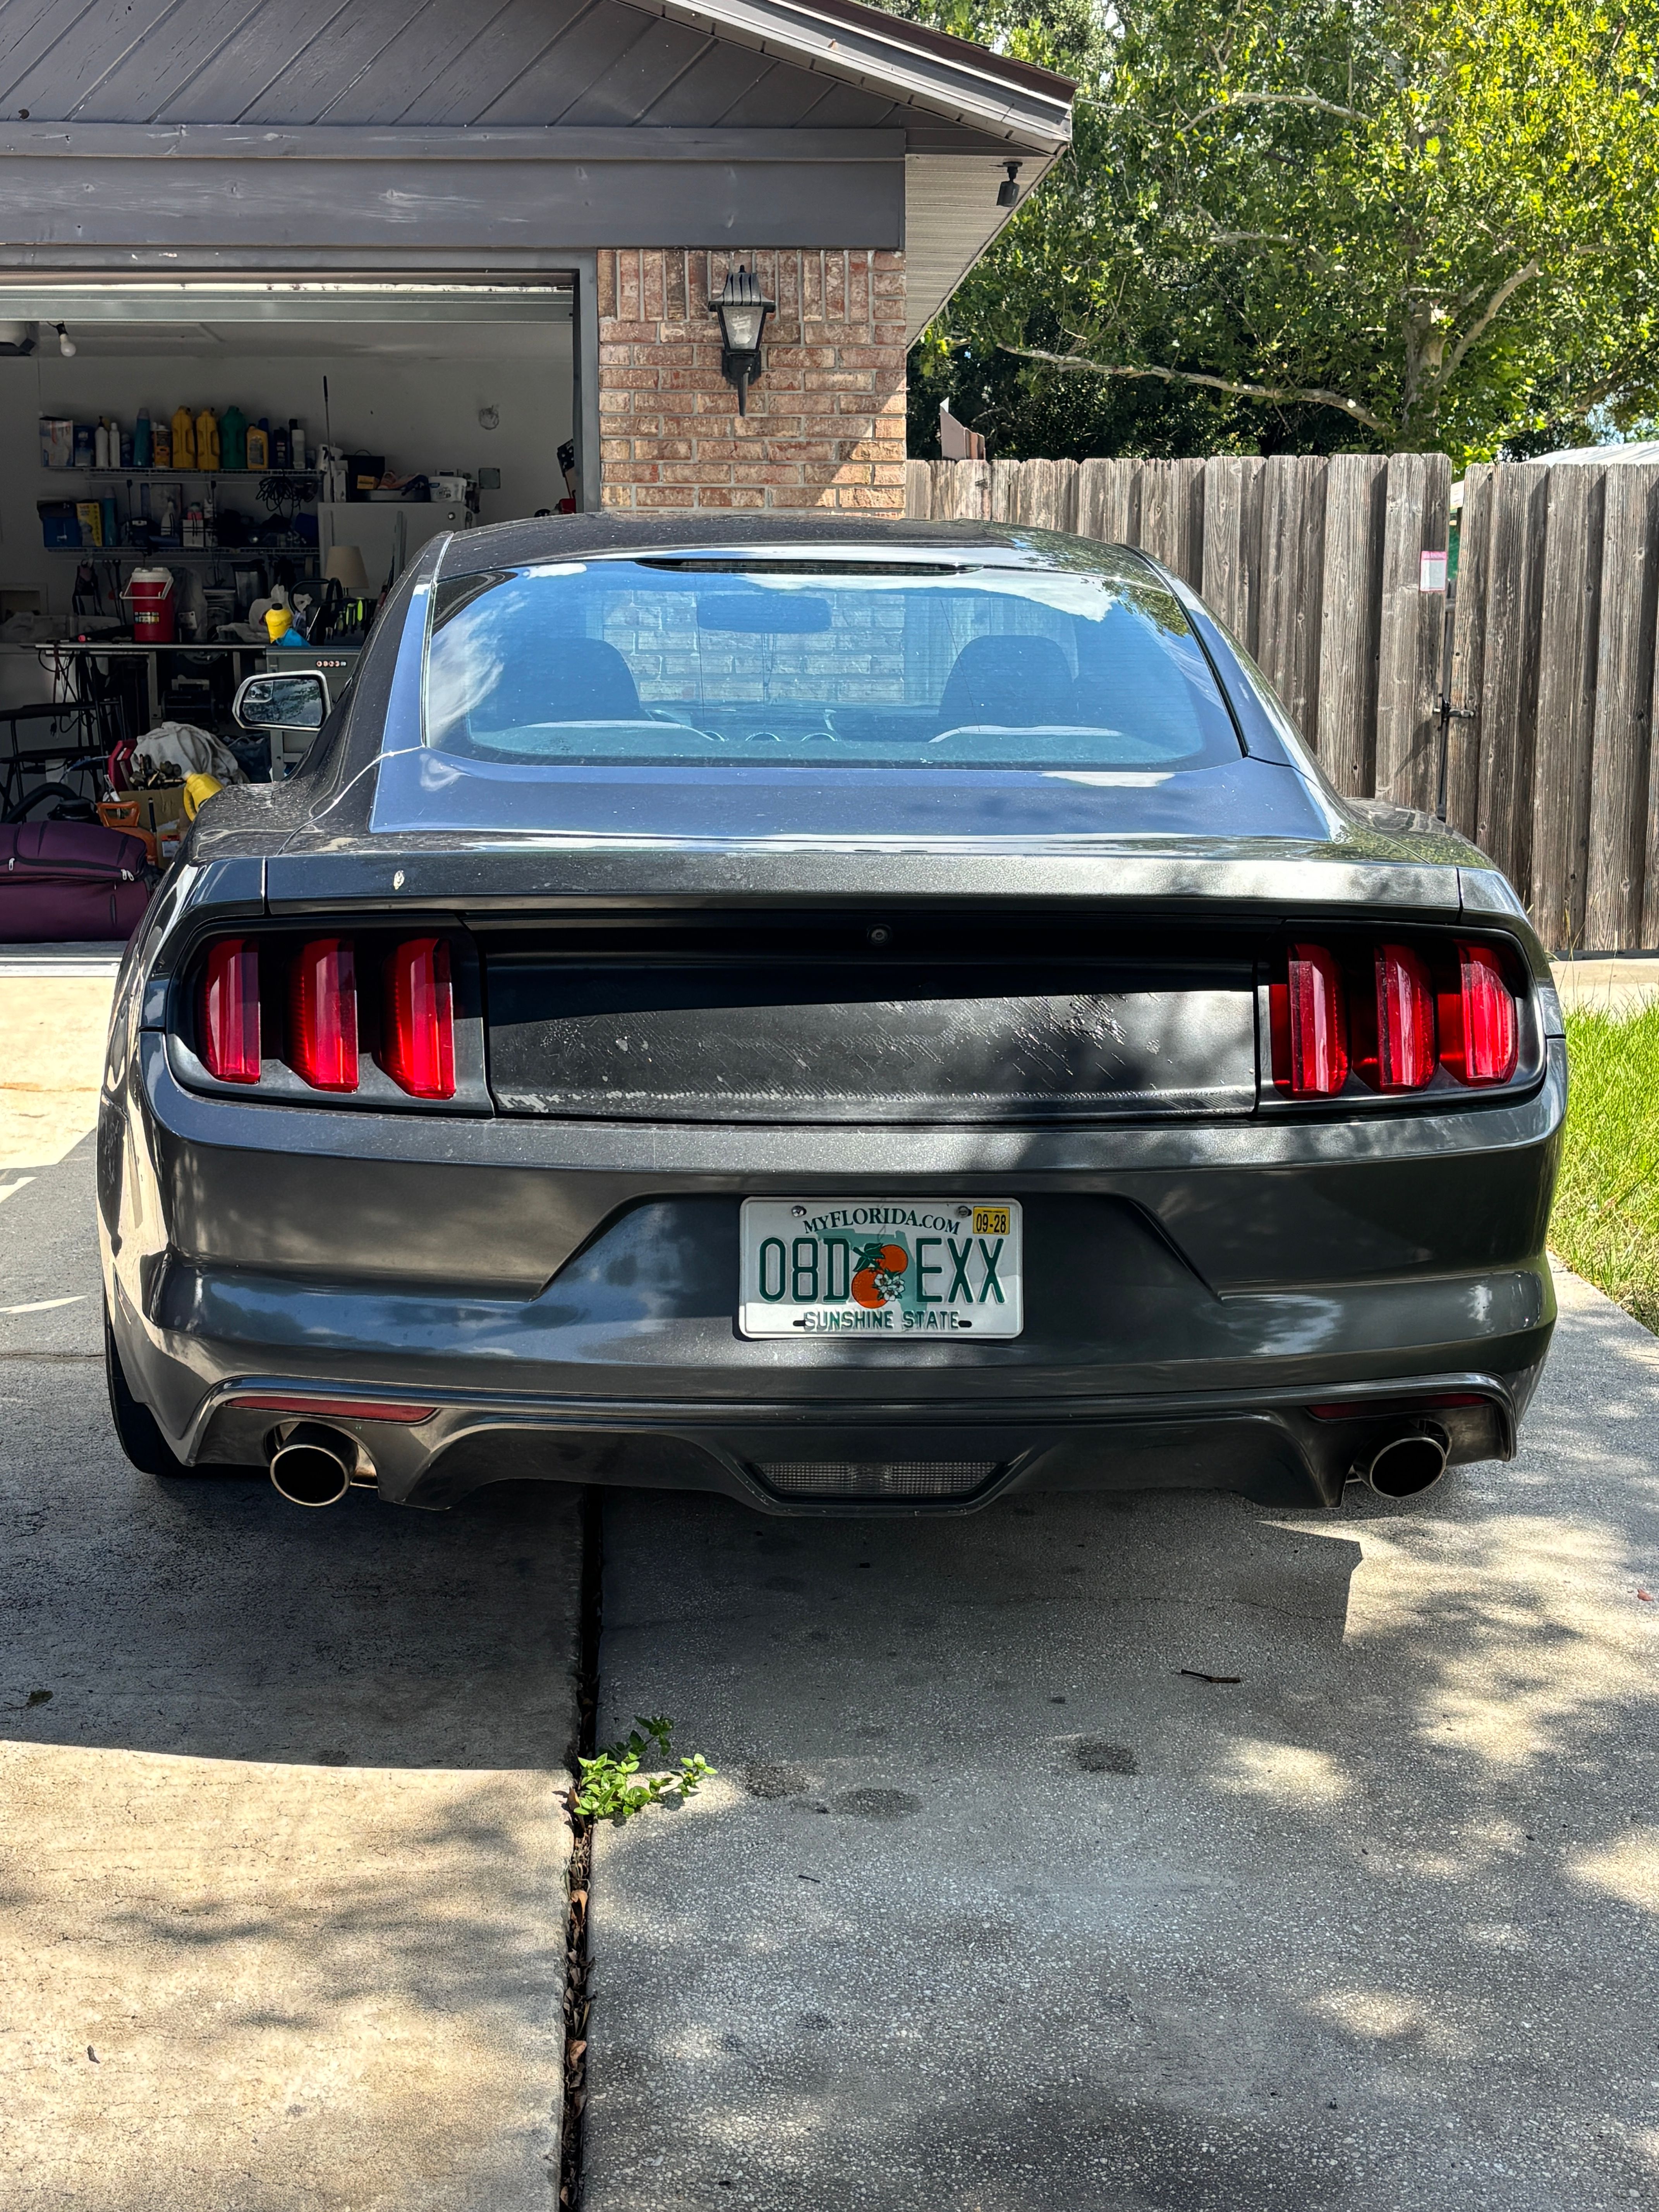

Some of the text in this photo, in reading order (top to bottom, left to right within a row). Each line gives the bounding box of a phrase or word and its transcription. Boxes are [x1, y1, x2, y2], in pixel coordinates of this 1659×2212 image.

[802, 1208, 961, 1235] MYFLORIDA.COM
[976, 1213, 1006, 1233] 09-28
[759, 1237, 1005, 1303] 08D EXX
[805, 1310, 959, 1331] SUNSHINE STATE
